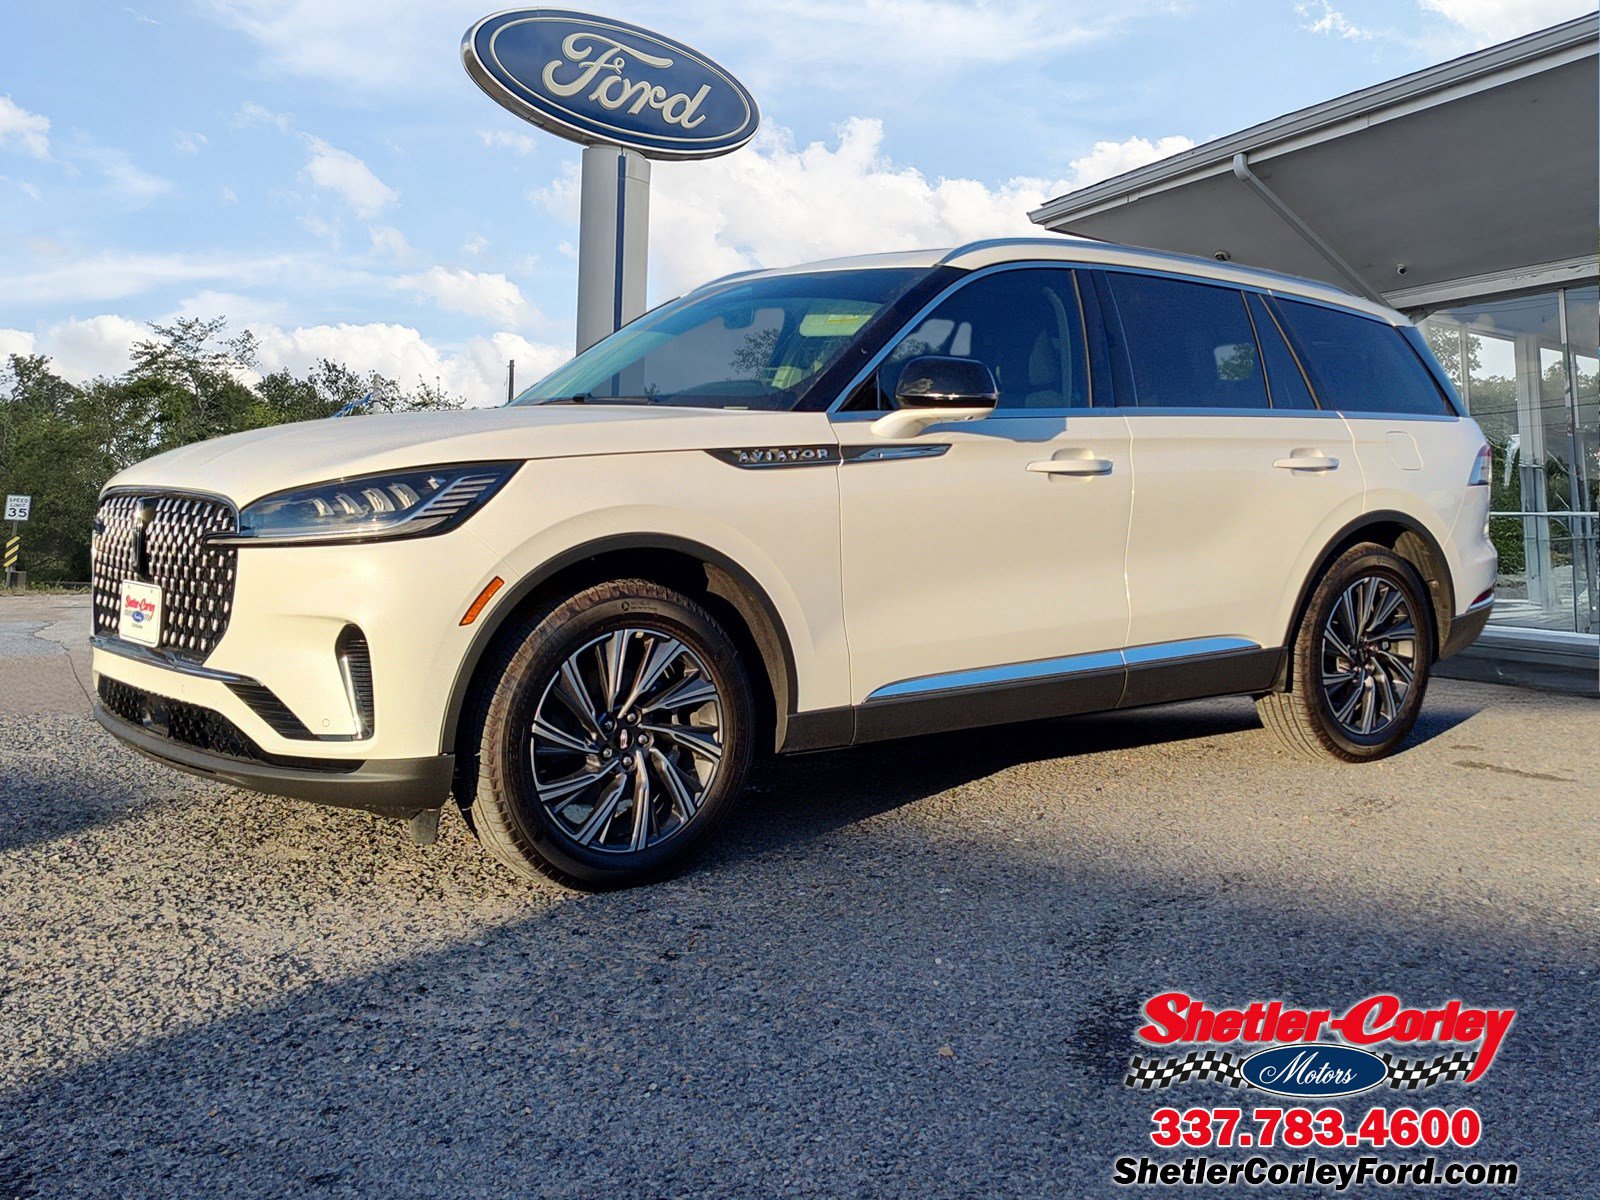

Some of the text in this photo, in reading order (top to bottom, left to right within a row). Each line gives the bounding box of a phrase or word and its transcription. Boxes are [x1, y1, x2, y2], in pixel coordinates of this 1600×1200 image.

[542, 32, 710, 130] Ford
[739, 449, 829, 463] AVIATOR
[8, 508, 27, 517] 35
